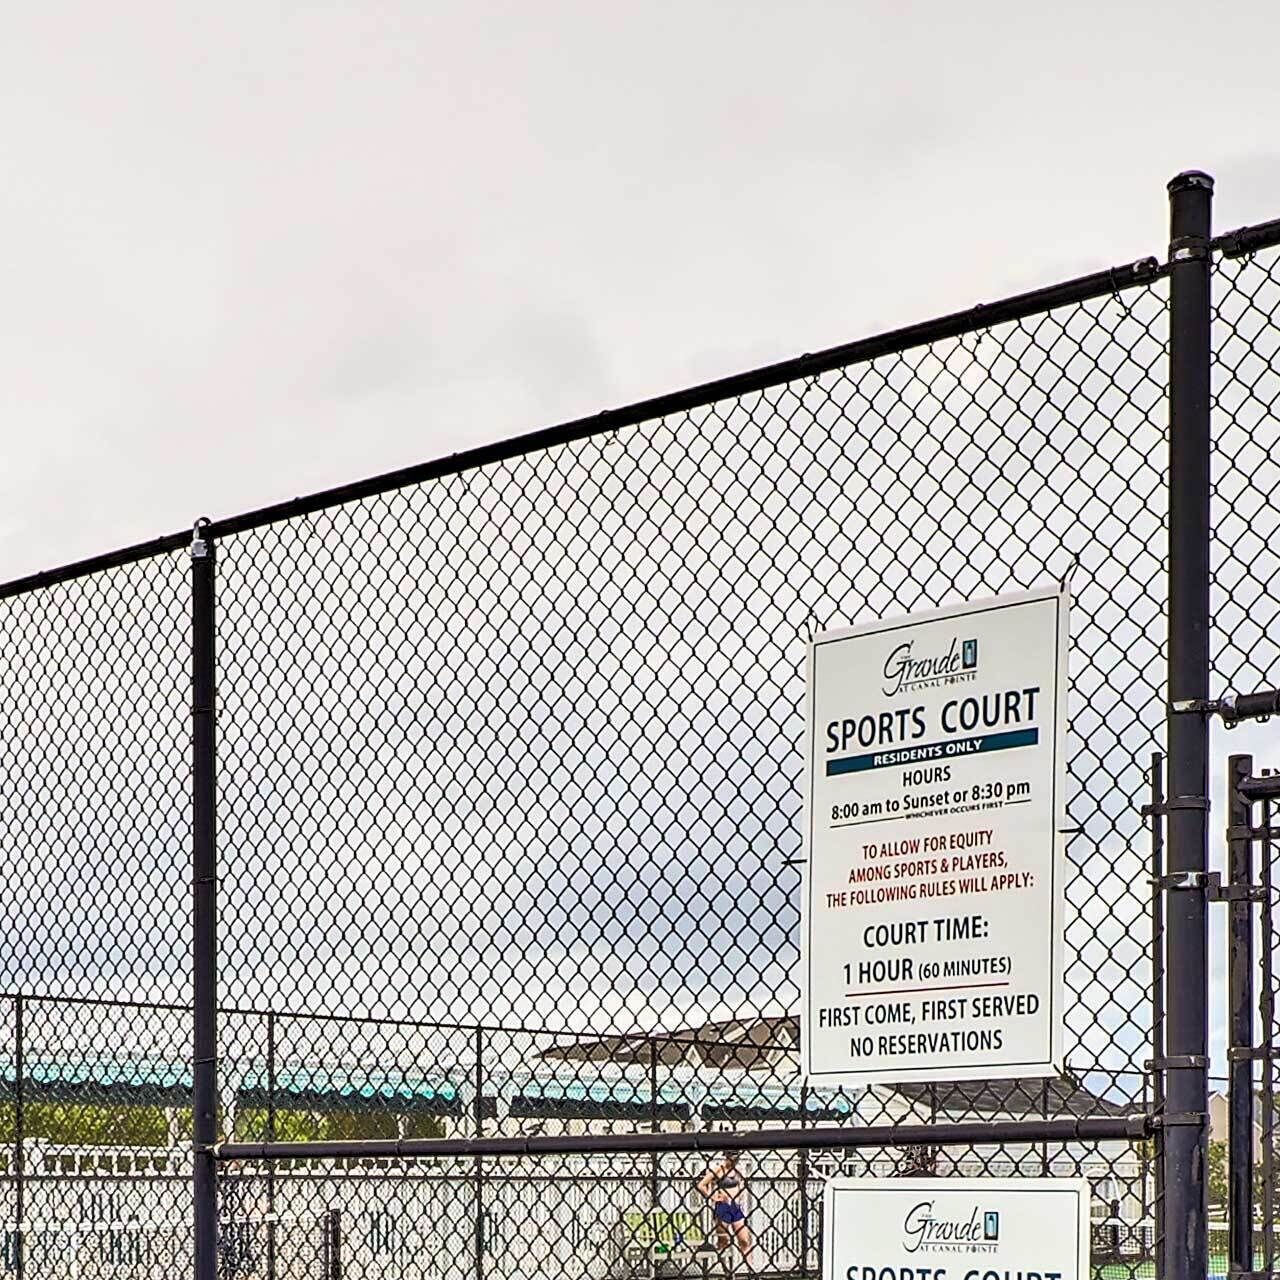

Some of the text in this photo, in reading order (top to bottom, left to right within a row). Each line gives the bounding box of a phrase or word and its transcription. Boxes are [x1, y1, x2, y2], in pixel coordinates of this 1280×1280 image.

[882, 637, 960, 697] Grande
[826, 686, 1040, 753] SPORTS COURT
[874, 740, 983, 766] RESIDENTS ONLY
[902, 766, 951, 787] HOURS
[831, 781, 1030, 820] 8:00 am to Sunset or 8:30 pm
[904, 800, 1003, 820] WHICHEVER OCCURS FIRST
[862, 830, 993, 860] TO ALLOW FOR EQUITY
[848, 850, 1008, 884] AMONG SPORTS & PLAYERS,
[826, 872, 1034, 908] THE FOLLOWING RULES WILL APPLY:
[864, 916, 988, 948] COURT TIME:
[844, 956, 1012, 984] 1 HOUR (60 MINUTES)
[820, 994, 1039, 1028] FIRST COME, FIRST SERVED
[850, 1030, 1002, 1057] NO RESERVATIONS
[902, 1200, 981, 1252] Grande
